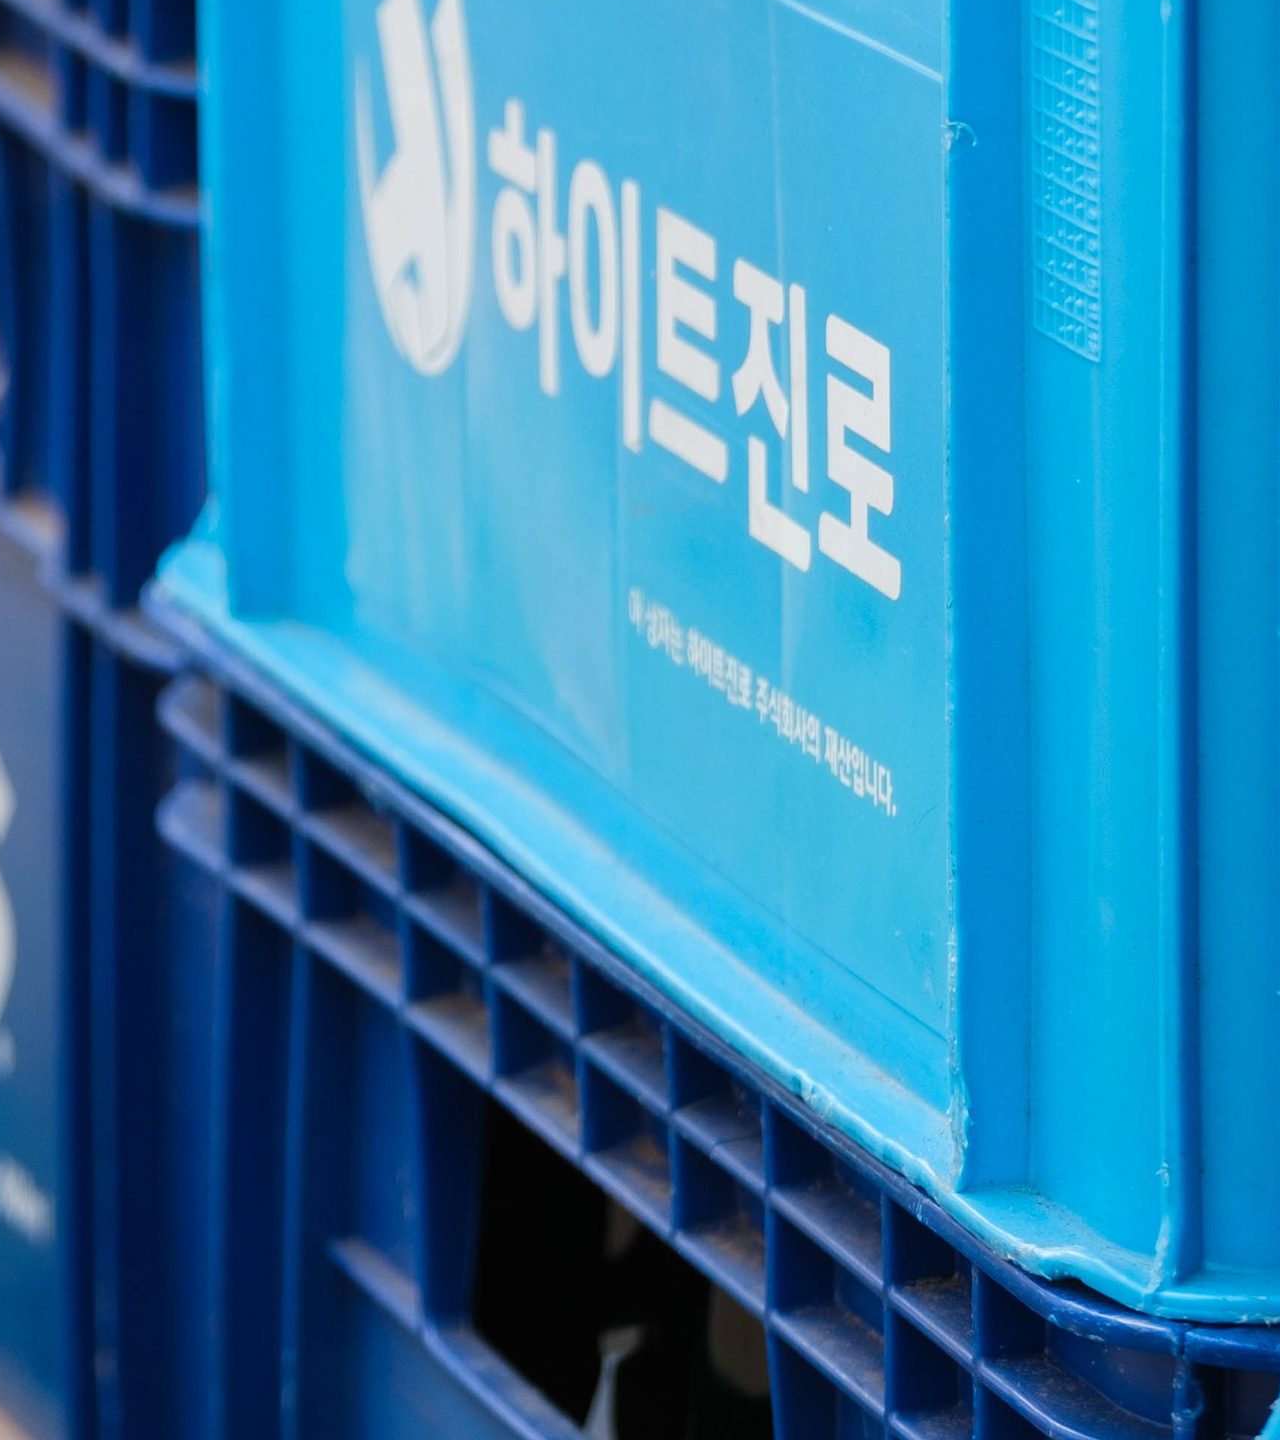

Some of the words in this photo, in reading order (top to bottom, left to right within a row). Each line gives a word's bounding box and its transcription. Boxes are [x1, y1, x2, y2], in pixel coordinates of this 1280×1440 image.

[488, 98, 901, 601] 하이트진로
[687, 625, 752, 710] 하이트진로
[755, 676, 820, 764] 주식회사의
[824, 725, 897, 818] 재산입니다.
